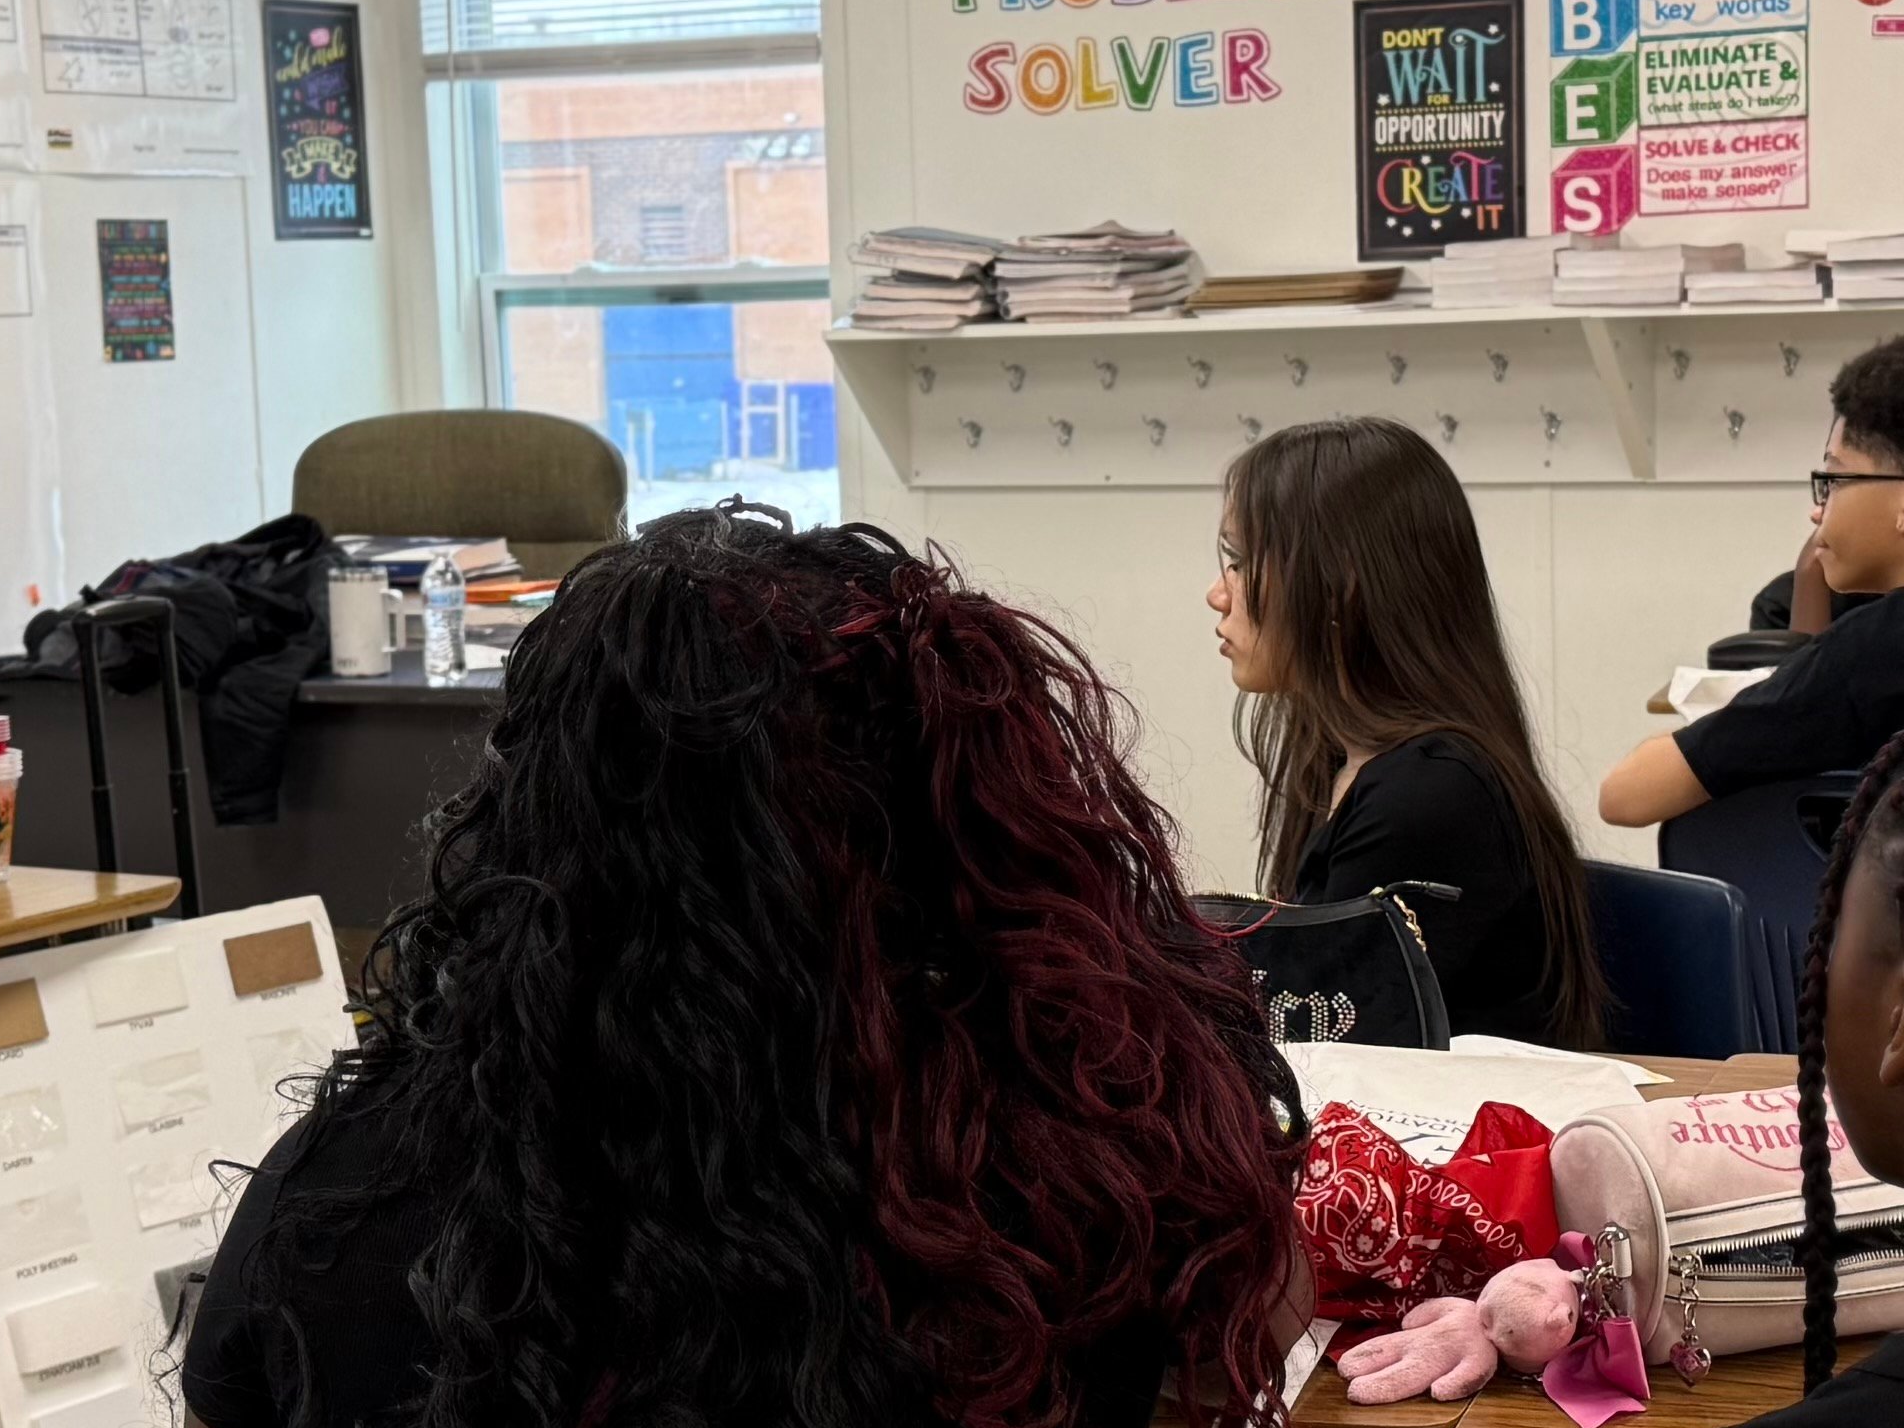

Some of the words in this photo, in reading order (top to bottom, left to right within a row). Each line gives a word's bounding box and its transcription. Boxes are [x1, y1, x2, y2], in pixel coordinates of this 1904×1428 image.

[1654, 0, 1696, 22] key
[1382, 26, 1445, 50] DON'T
[1382, 28, 1506, 106] WAIT
[1645, 42, 1777, 70] ELIMINATE
[962, 27, 1283, 116] SOLVER
[1646, 70, 1771, 95] EVALUATE
[1778, 60, 1799, 82] &
[1426, 94, 1451, 107] FOR
[1564, 84, 1600, 140] E
[1648, 98, 1684, 114] (what
[1688, 98, 1722, 113] steps
[1728, 98, 1743, 110] do
[1374, 110, 1506, 146] OPPORTUNITY
[1646, 138, 1708, 159] SOLVE
[1712, 138, 1727, 154] &
[1730, 133, 1801, 154] CHECK
[1376, 150, 1505, 214] CREATE
[1646, 167, 1692, 184] Does
[1698, 166, 1726, 183] my
[1730, 162, 1798, 180] answer
[287, 182, 356, 219] HAPPEN
[1562, 176, 1602, 232] S
[1661, 184, 1708, 200] make
[1715, 180, 1781, 198] sense?
[1476, 204, 1506, 231] IT
